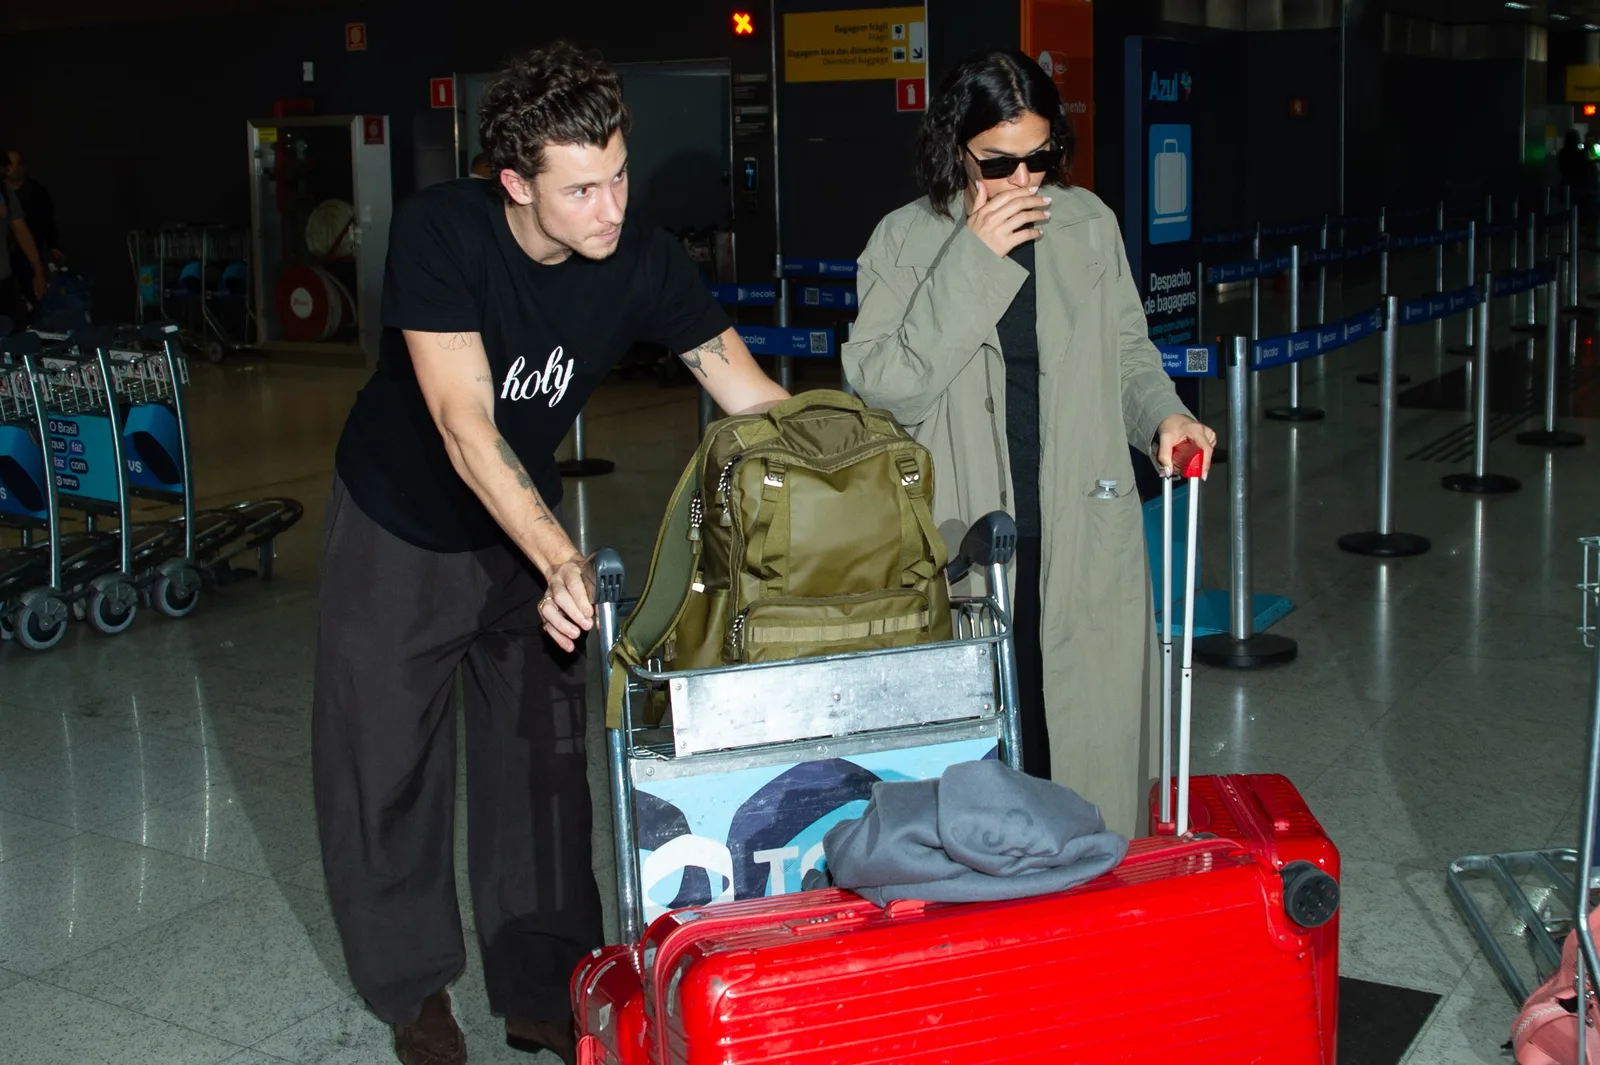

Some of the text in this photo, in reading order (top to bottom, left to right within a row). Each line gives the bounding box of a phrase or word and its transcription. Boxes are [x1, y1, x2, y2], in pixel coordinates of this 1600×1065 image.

[834, 25, 867, 34] Bagagem
[787, 49, 819, 59] Bagagem
[836, 47, 849, 55] das
[1149, 71, 1178, 102] Azul
[830, 264, 854, 272] decolar
[1150, 268, 1191, 293] Despacho
[750, 290, 775, 298] decola
[1144, 291, 1196, 315] de bagagens
[1162, 352, 1179, 360] Baixe
[1168, 360, 1182, 369] App!
[500, 345, 575, 408] holy
[49, 420, 78, 435] O Brasil
[51, 439, 83, 453] que faz
[70, 461, 87, 472] com
